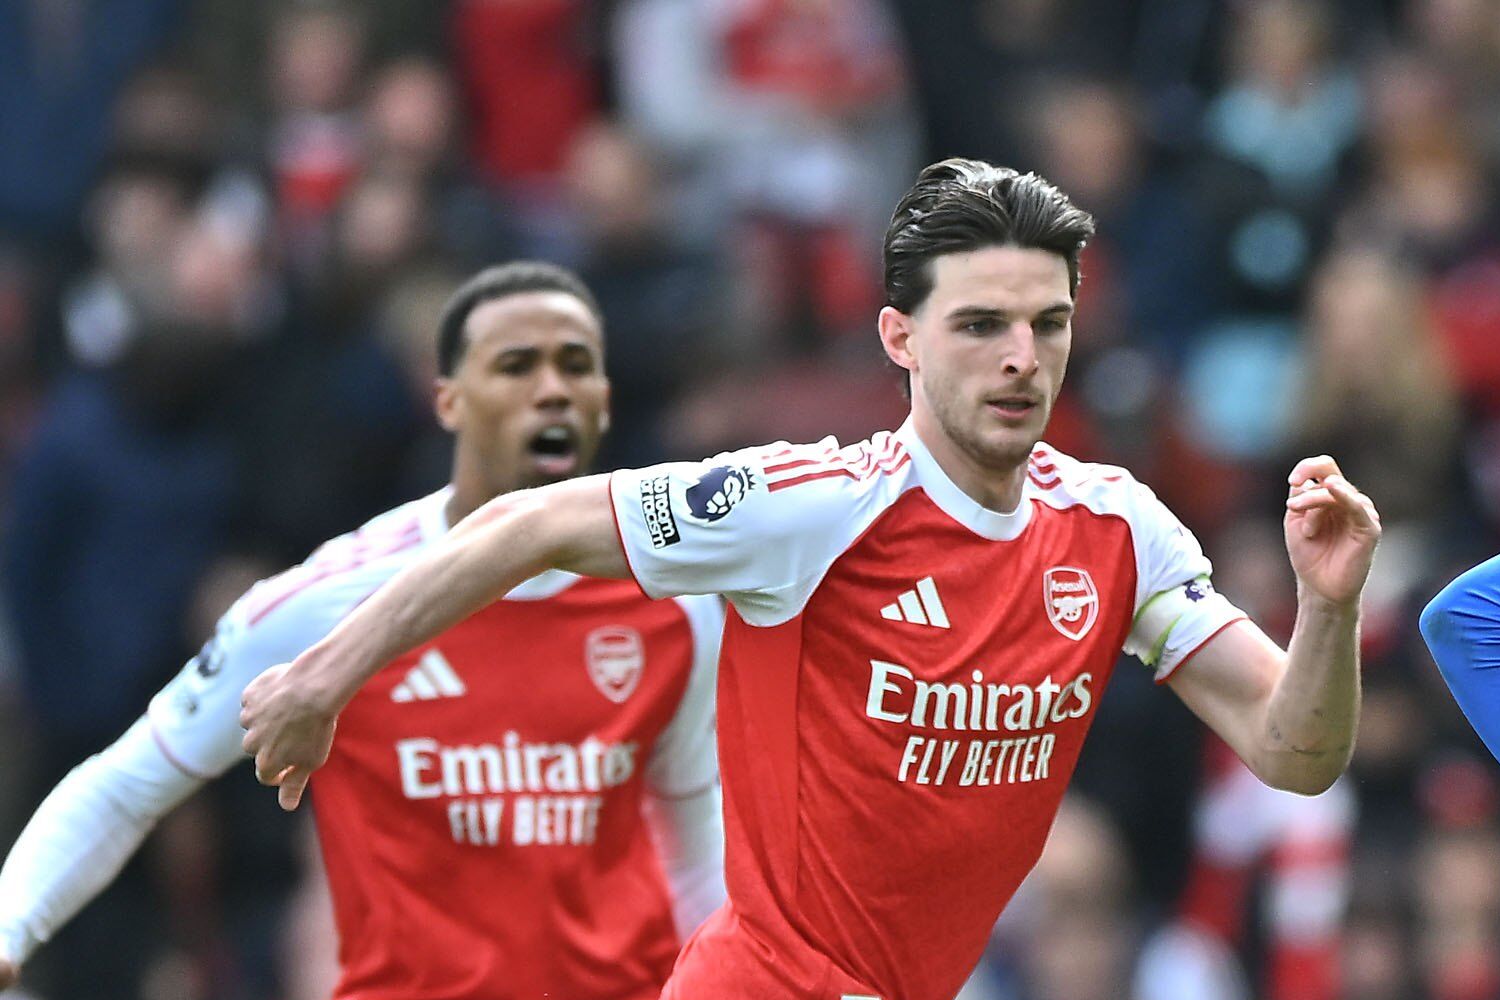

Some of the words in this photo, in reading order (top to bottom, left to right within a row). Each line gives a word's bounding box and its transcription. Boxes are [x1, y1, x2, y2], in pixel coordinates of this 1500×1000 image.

[654, 493, 676, 538] room
[897, 736, 959, 786] FLY
[958, 733, 1056, 787] BETTER
[447, 797, 504, 847] FLY
